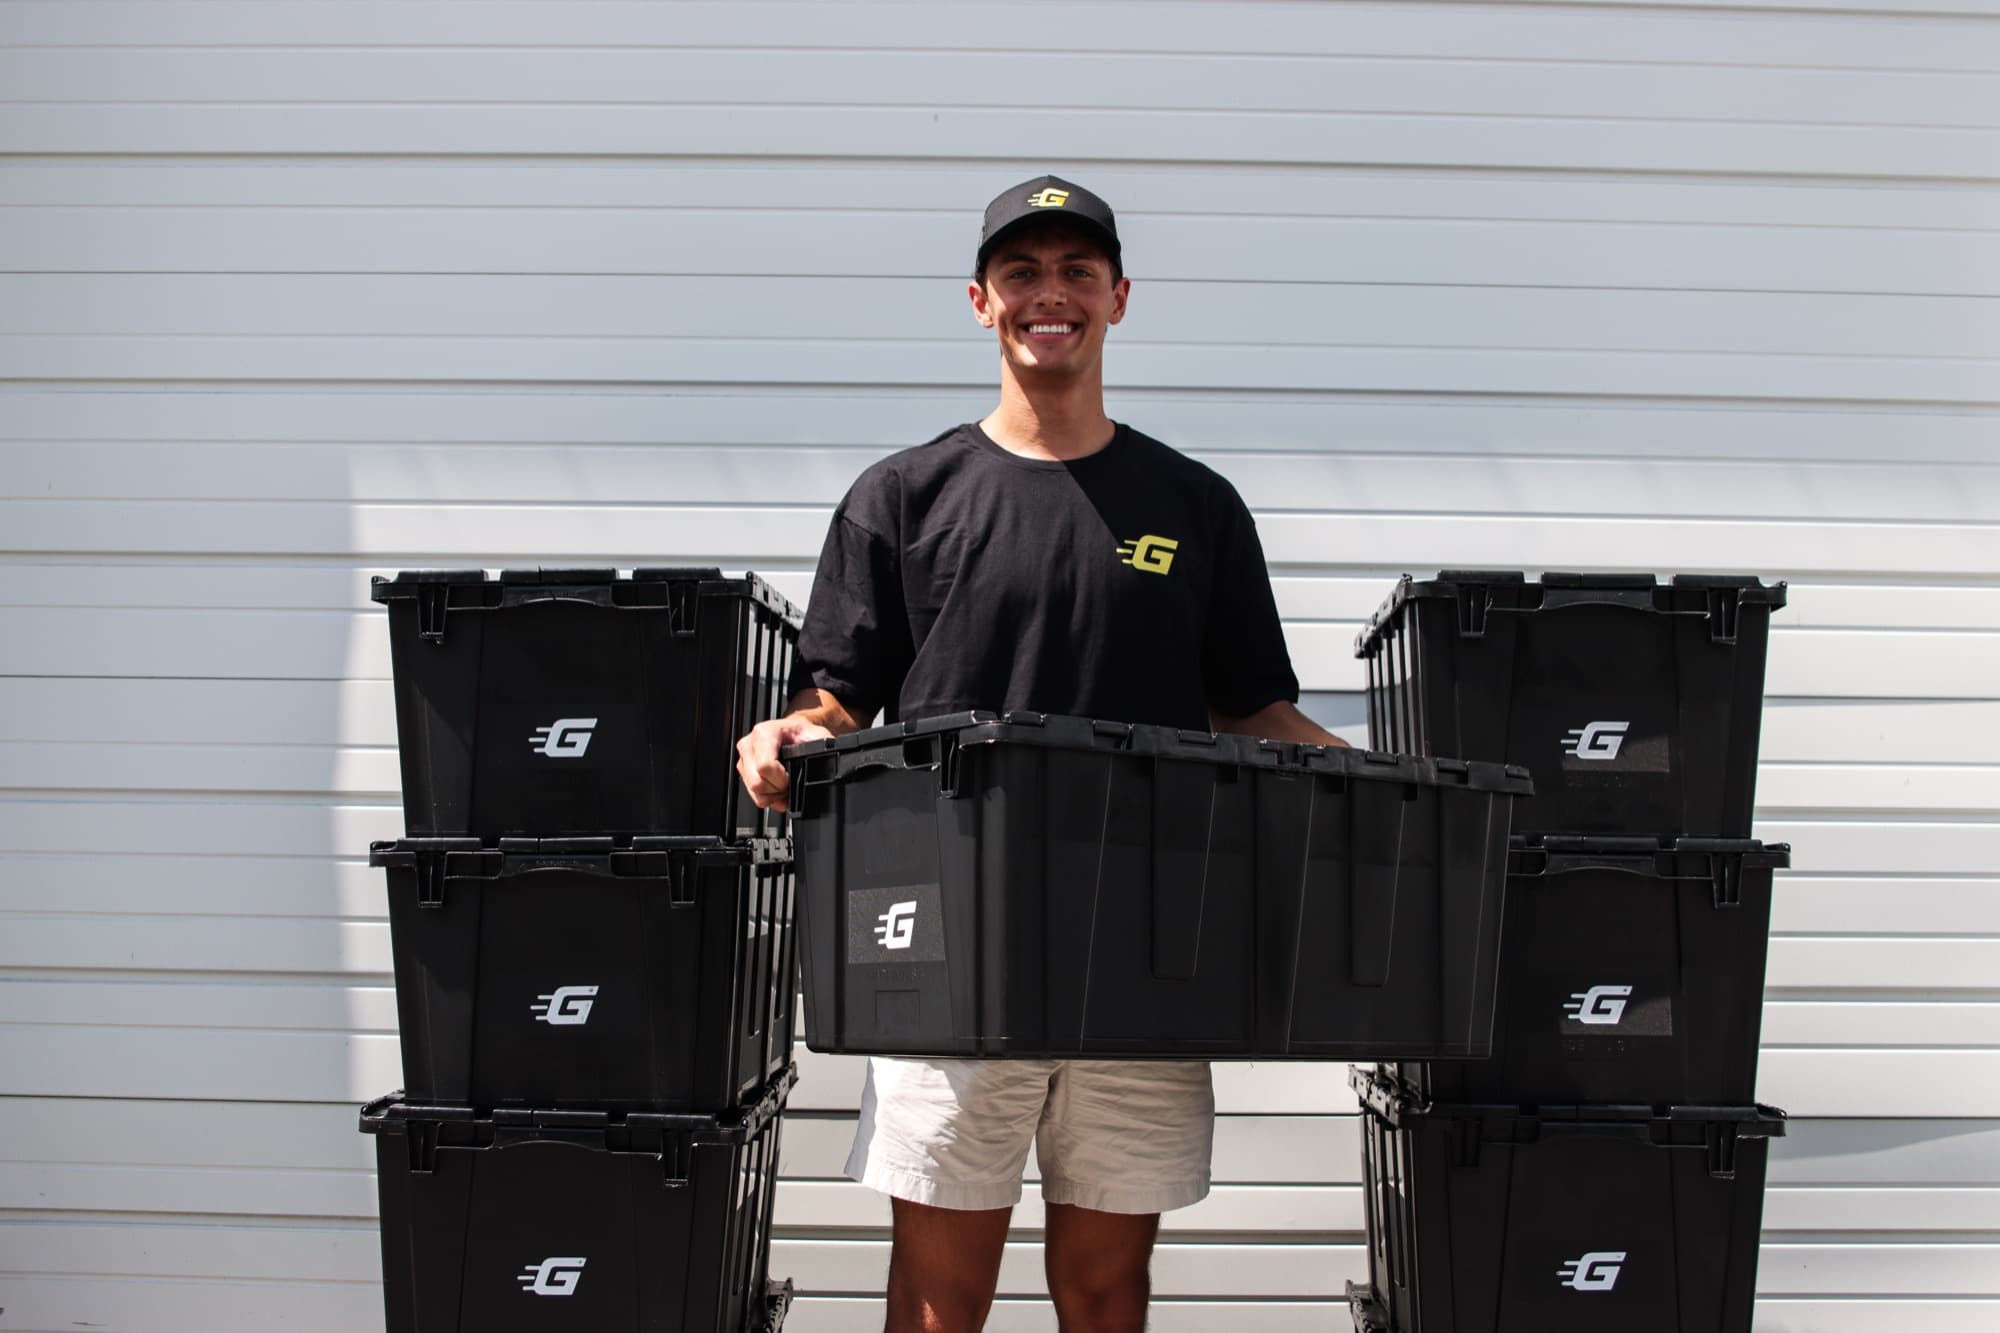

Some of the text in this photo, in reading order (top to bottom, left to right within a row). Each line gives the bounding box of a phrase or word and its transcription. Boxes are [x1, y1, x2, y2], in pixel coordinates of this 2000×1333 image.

[1040, 188, 1069, 207] G
[1132, 535, 1178, 575] G
[544, 717, 598, 758] G
[1576, 721, 1630, 760] G
[885, 900, 918, 951] G
[547, 985, 599, 1025] G
[1579, 985, 1633, 1025] G
[533, 1257, 587, 1296] G
[1574, 1251, 1627, 1291] G
